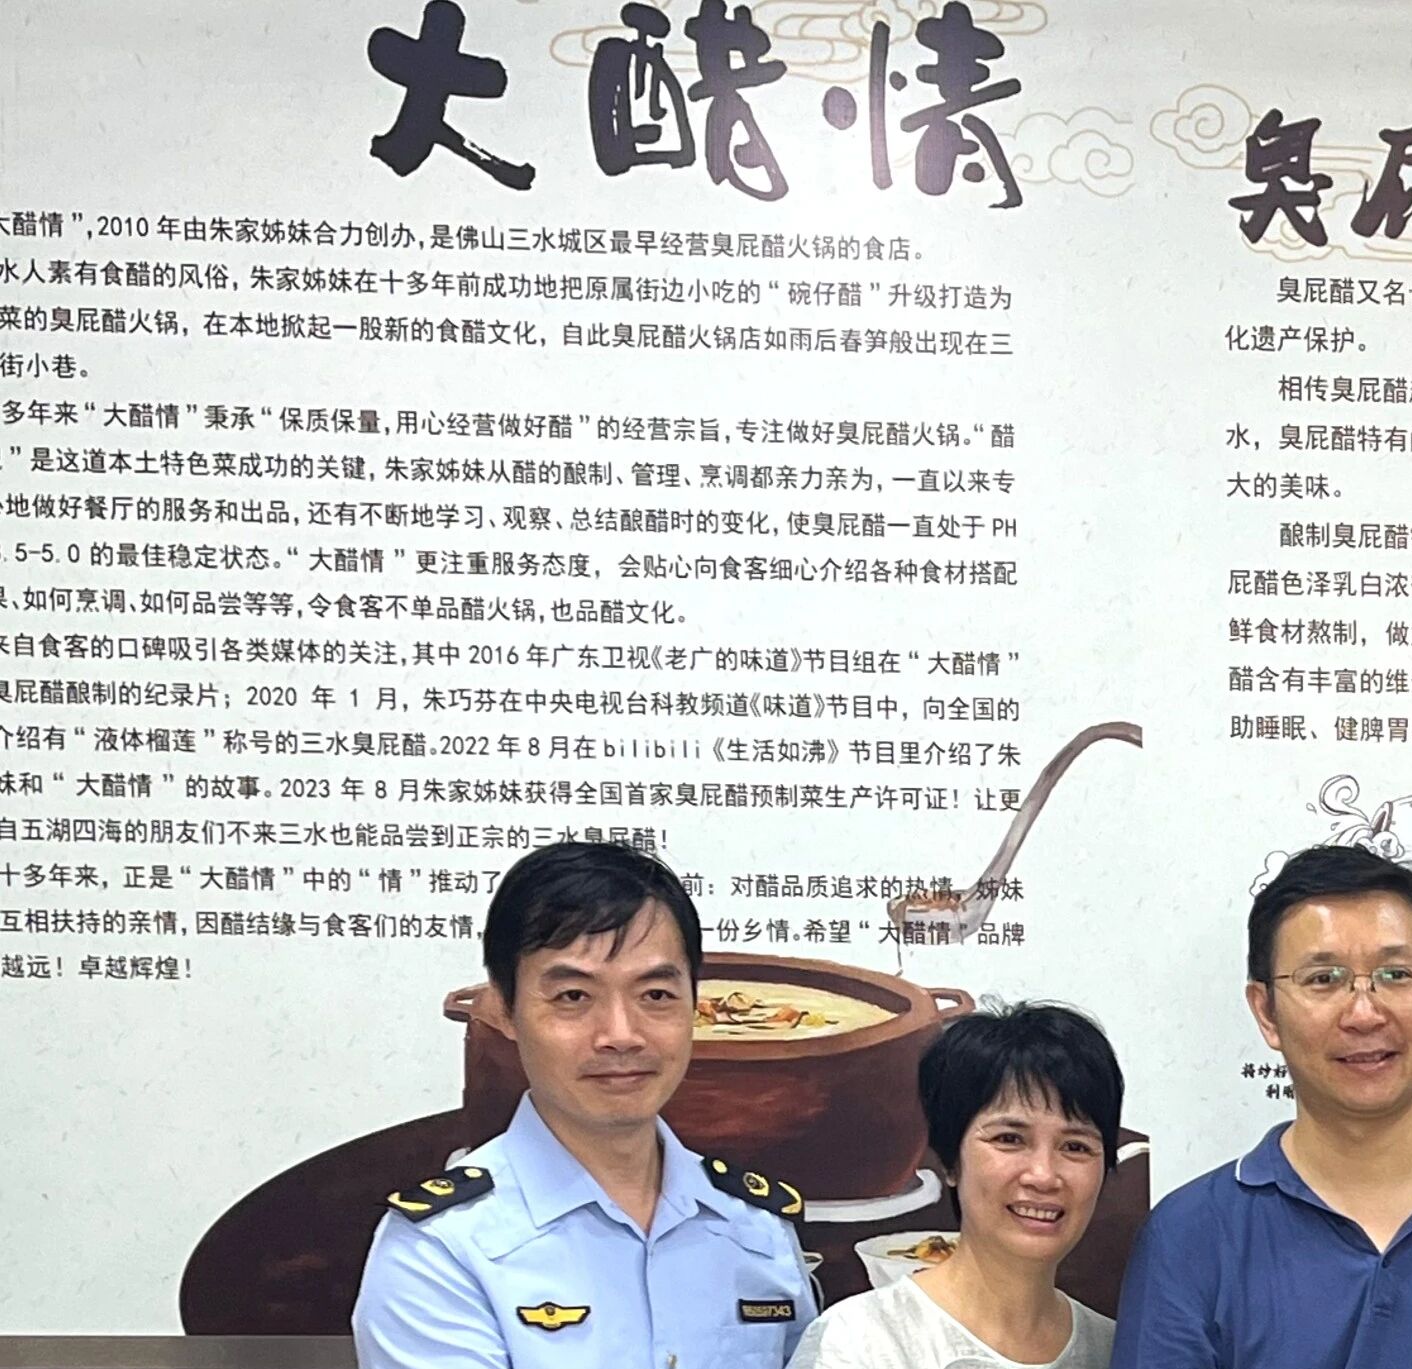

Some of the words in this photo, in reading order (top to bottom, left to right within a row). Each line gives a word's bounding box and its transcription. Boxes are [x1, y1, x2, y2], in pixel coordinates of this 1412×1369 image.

[366, 0, 1023, 209] 大醋情
[1225, 325, 1365, 353] 化遗产保护。
[1227, 472, 1341, 499] 大的美味。
